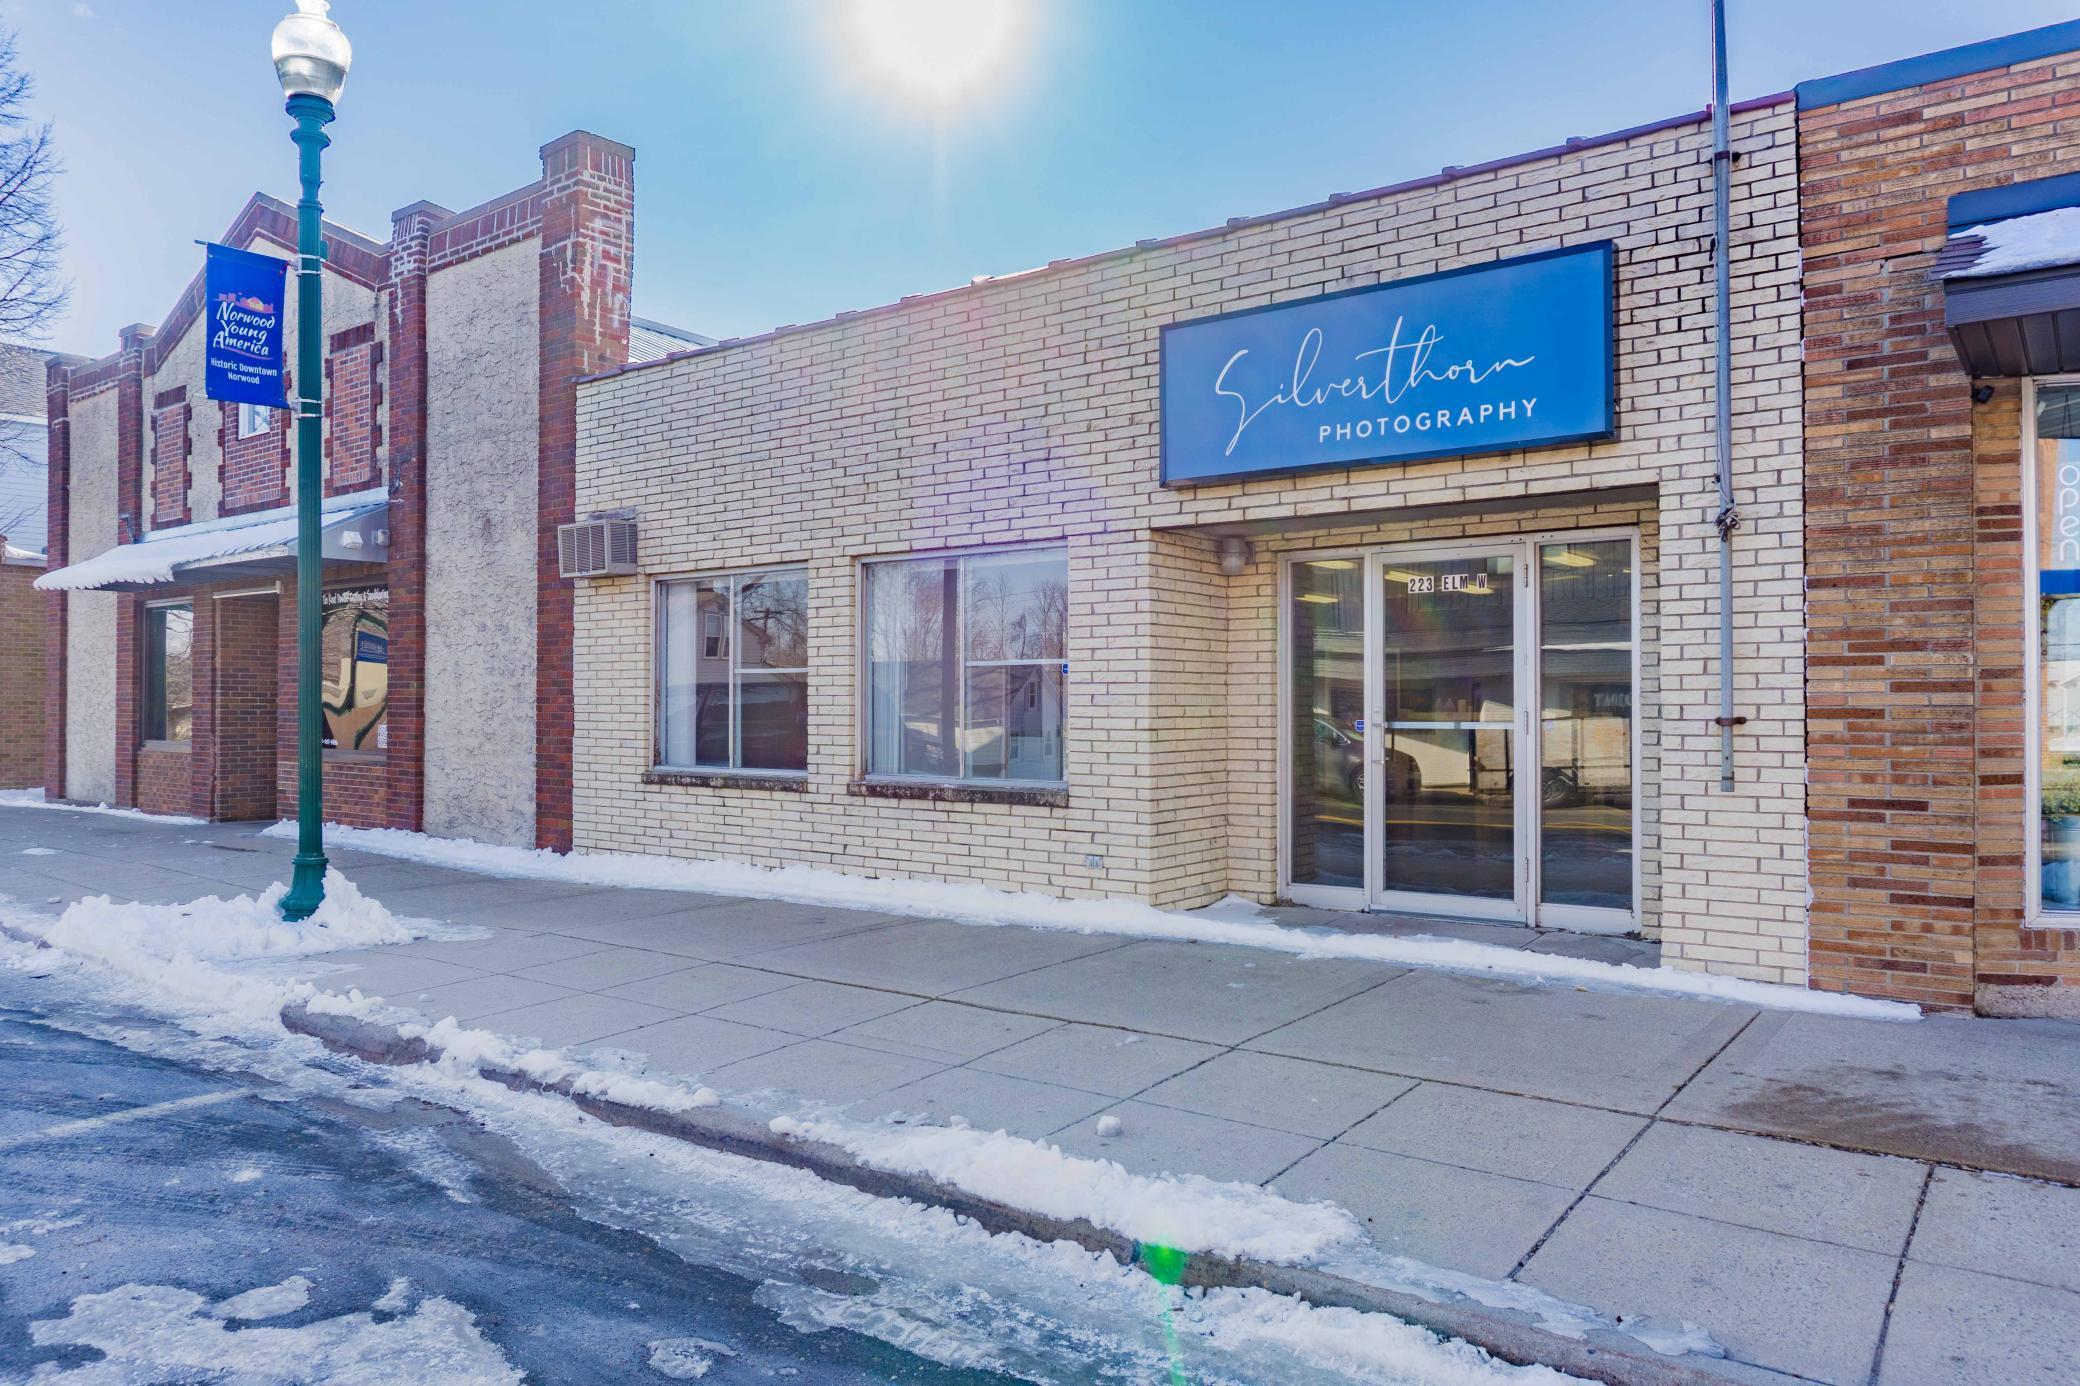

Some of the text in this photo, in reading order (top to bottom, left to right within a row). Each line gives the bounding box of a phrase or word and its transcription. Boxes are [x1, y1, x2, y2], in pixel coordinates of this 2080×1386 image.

[216, 301, 275, 329] Norwood
[212, 330, 269, 356] America
[220, 319, 267, 345] Young
[210, 357, 278, 377] Historic Downtown
[227, 371, 260, 385] Norwood
[1215, 315, 1536, 457] Silverthorn
[1318, 397, 1538, 444] PHOTOGRAPHY
[1409, 574, 1487, 592] 223 ELM W
